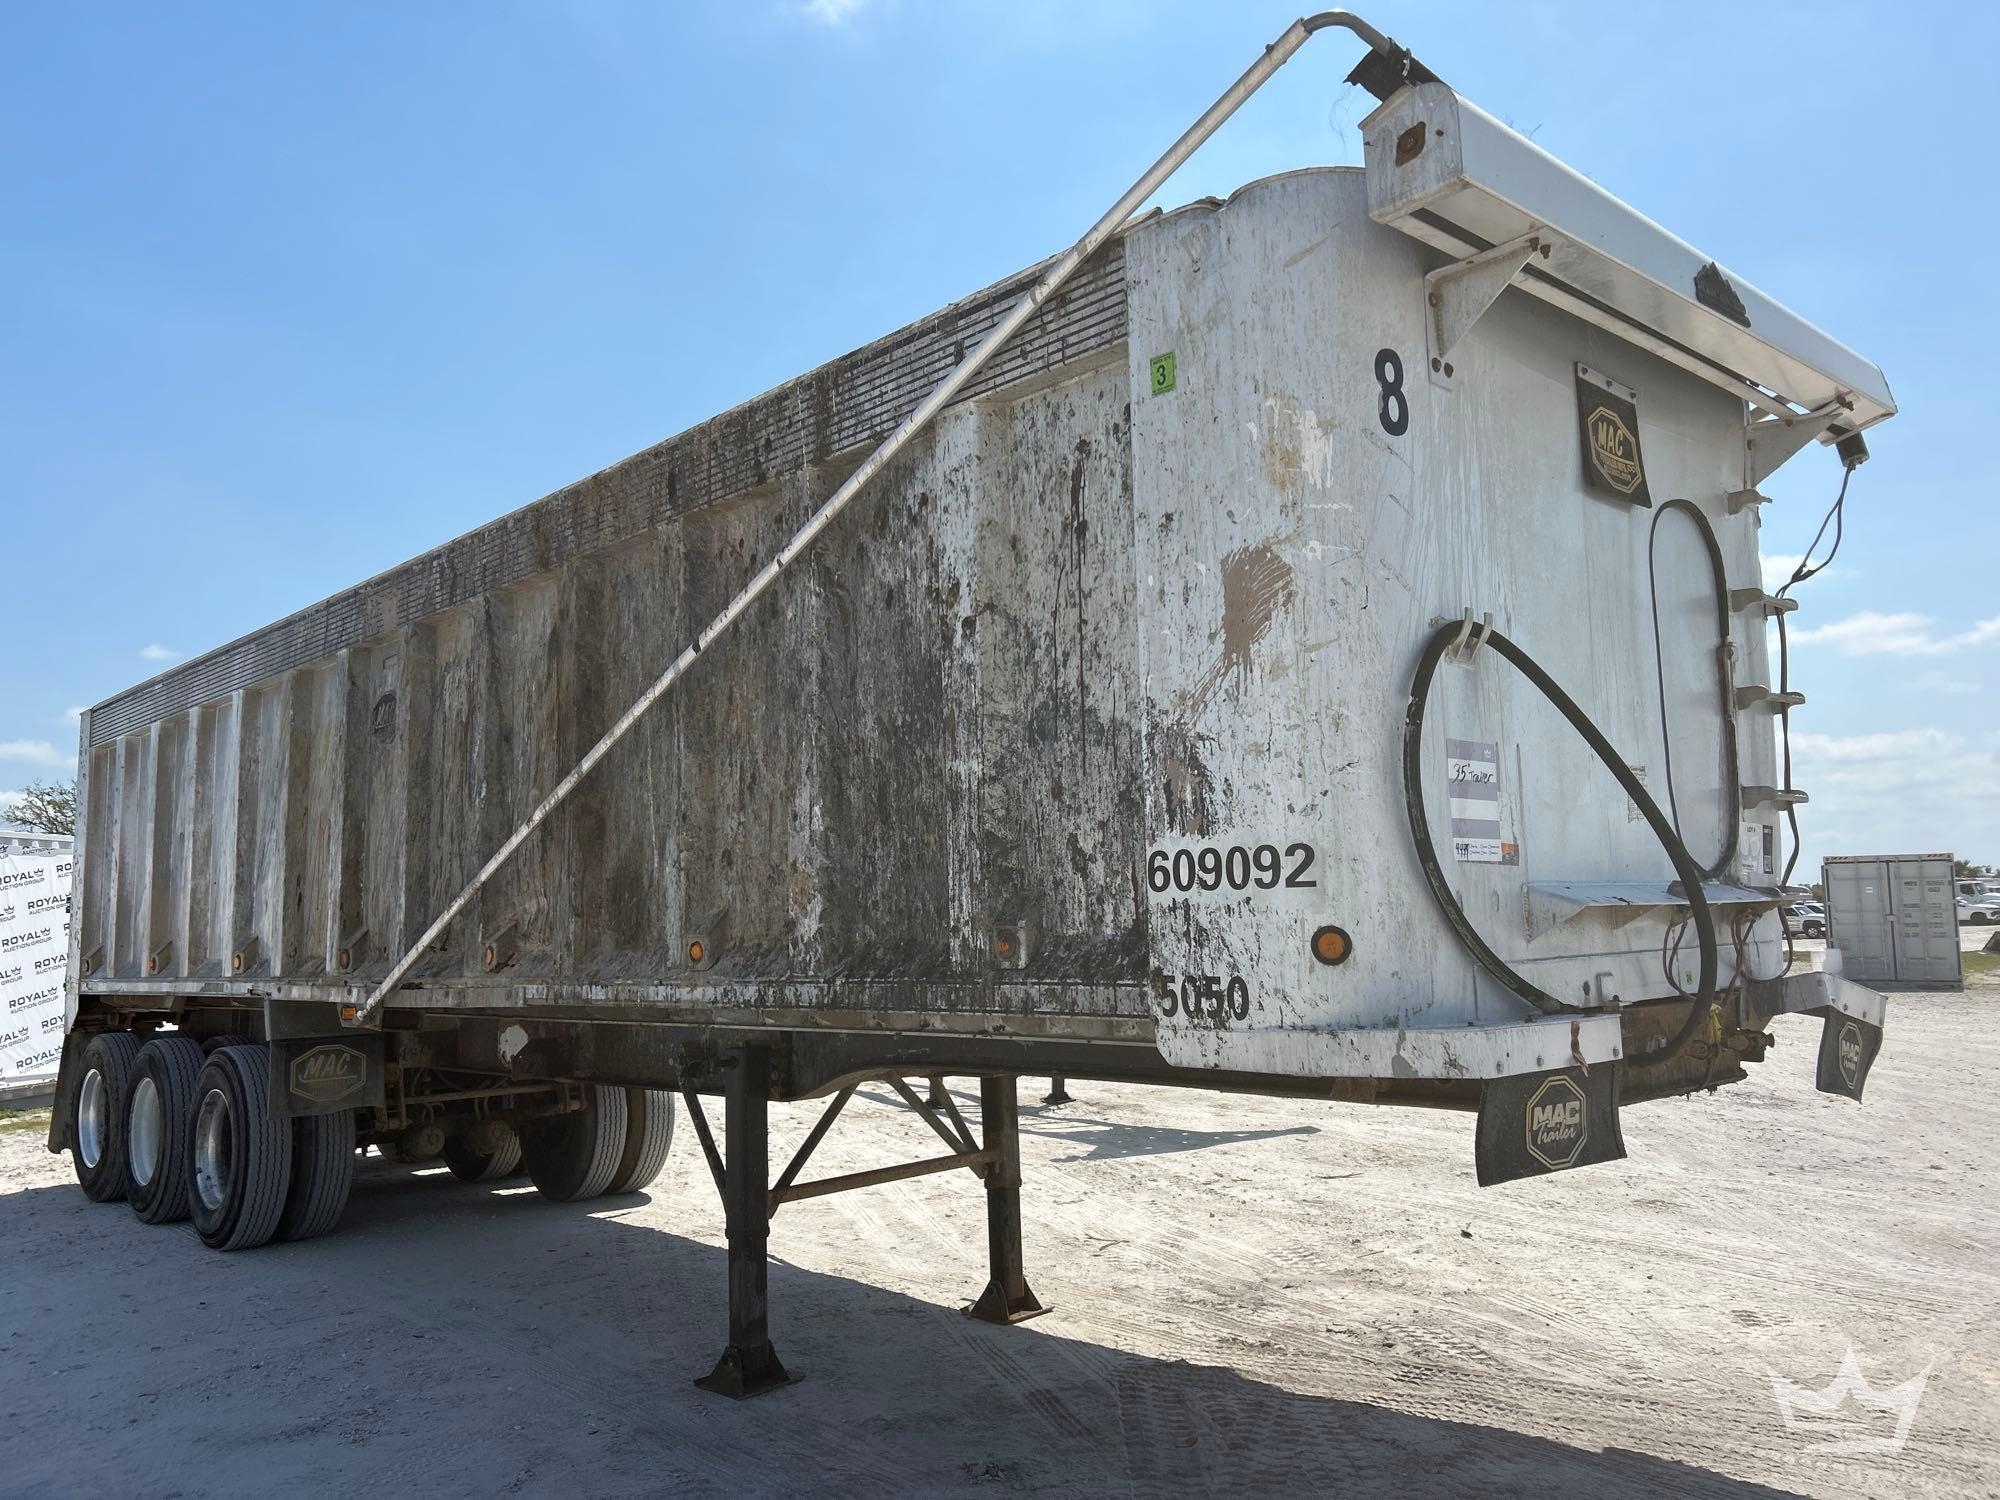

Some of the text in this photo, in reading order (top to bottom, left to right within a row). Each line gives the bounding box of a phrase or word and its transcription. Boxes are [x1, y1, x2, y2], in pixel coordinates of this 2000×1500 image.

[1156, 364, 1166, 386] 3
[1374, 348, 1409, 436] 8
[1598, 421, 1623, 456] MAC
[1147, 842, 1317, 893] 609092
[0, 882, 23, 891] UCTION
[28, 894, 65, 909] ROYAL
[29, 905, 55, 915] AUCTION
[2, 931, 41, 947] ROYAL
[3, 936, 52, 953] AUCTION GROUP
[35, 965, 62, 975] AUCTION
[9, 990, 48, 1008] ROYAL
[10, 995, 58, 1014] AUCTION GROUP
[1160, 975, 1250, 1021] 5050
[41, 1014, 65, 1029] ROY
[16, 1050, 54, 1069] ROYAL
[303, 1053, 351, 1079] MAC
[1533, 1100, 1581, 1131] MAC
[1537, 1120, 1577, 1145] Trailer
